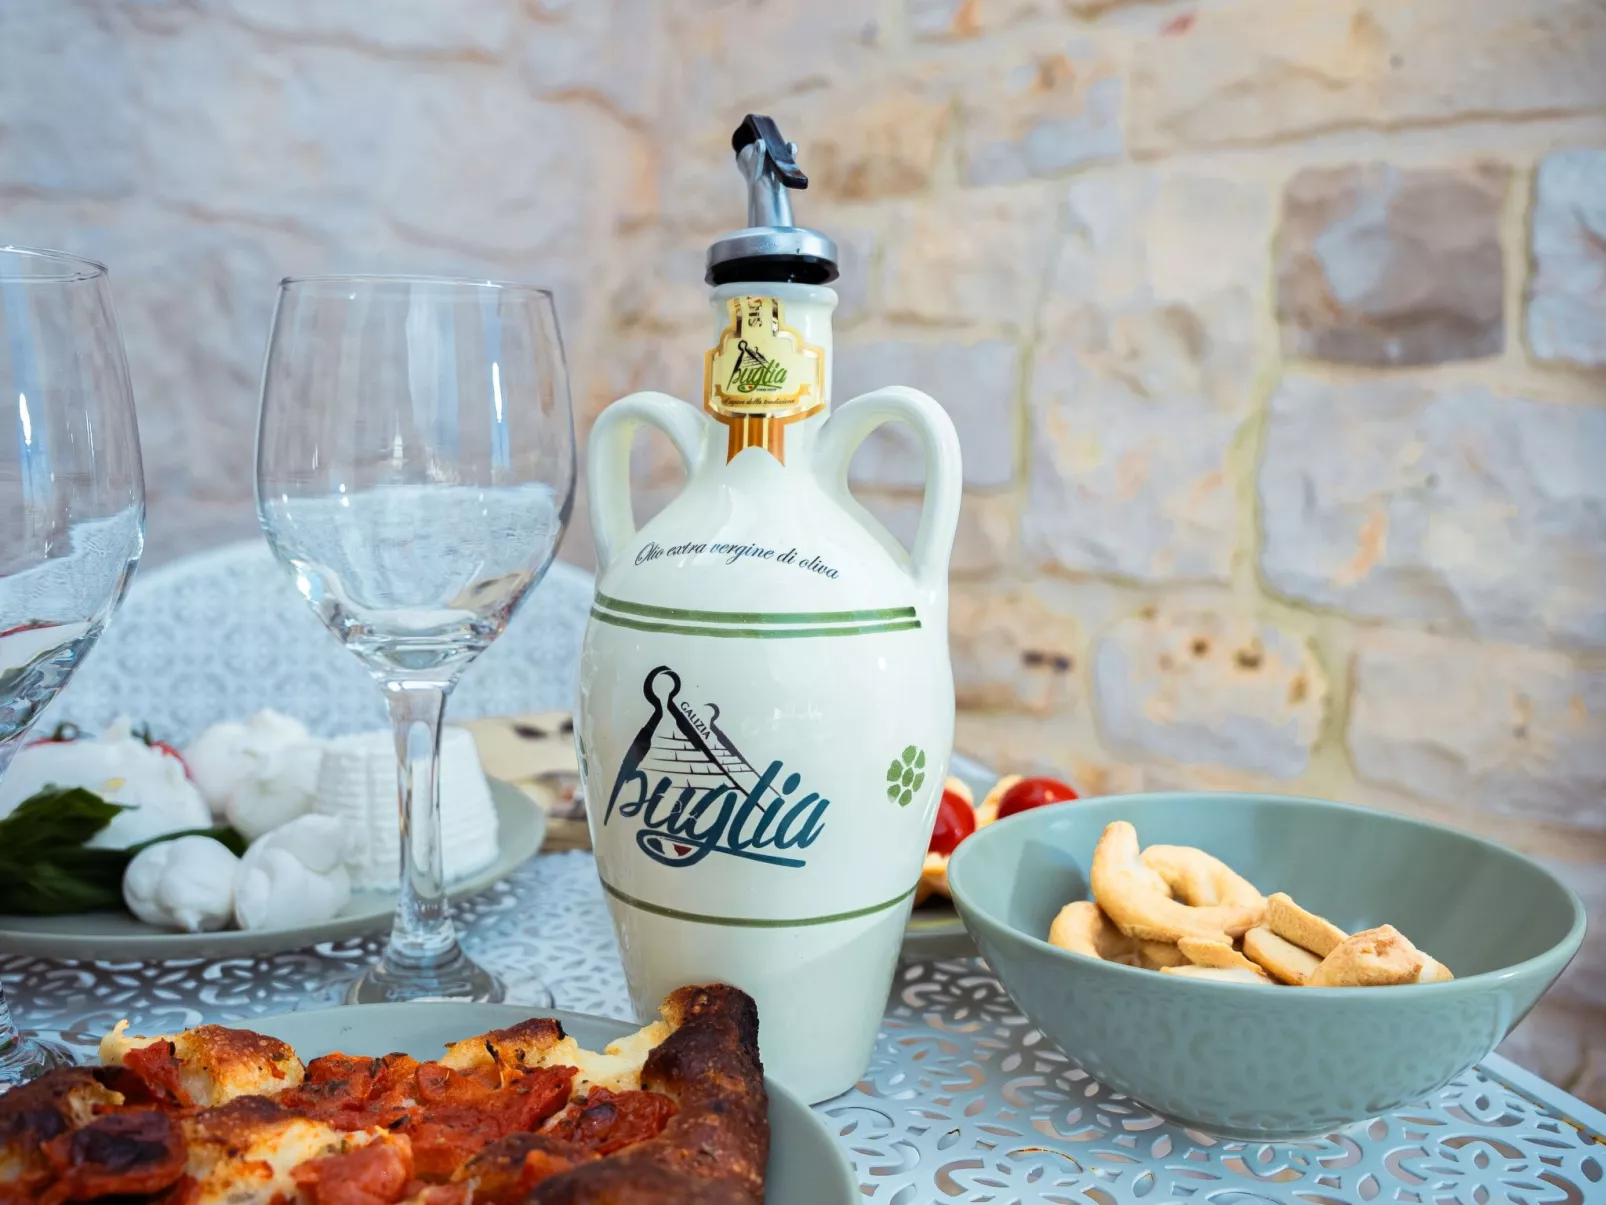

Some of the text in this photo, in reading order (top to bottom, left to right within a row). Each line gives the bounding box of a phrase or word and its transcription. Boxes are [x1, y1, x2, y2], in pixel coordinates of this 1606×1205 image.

[634, 541, 840, 580] Olio extra vergine di oliva
[680, 701, 712, 740] GALIZIA
